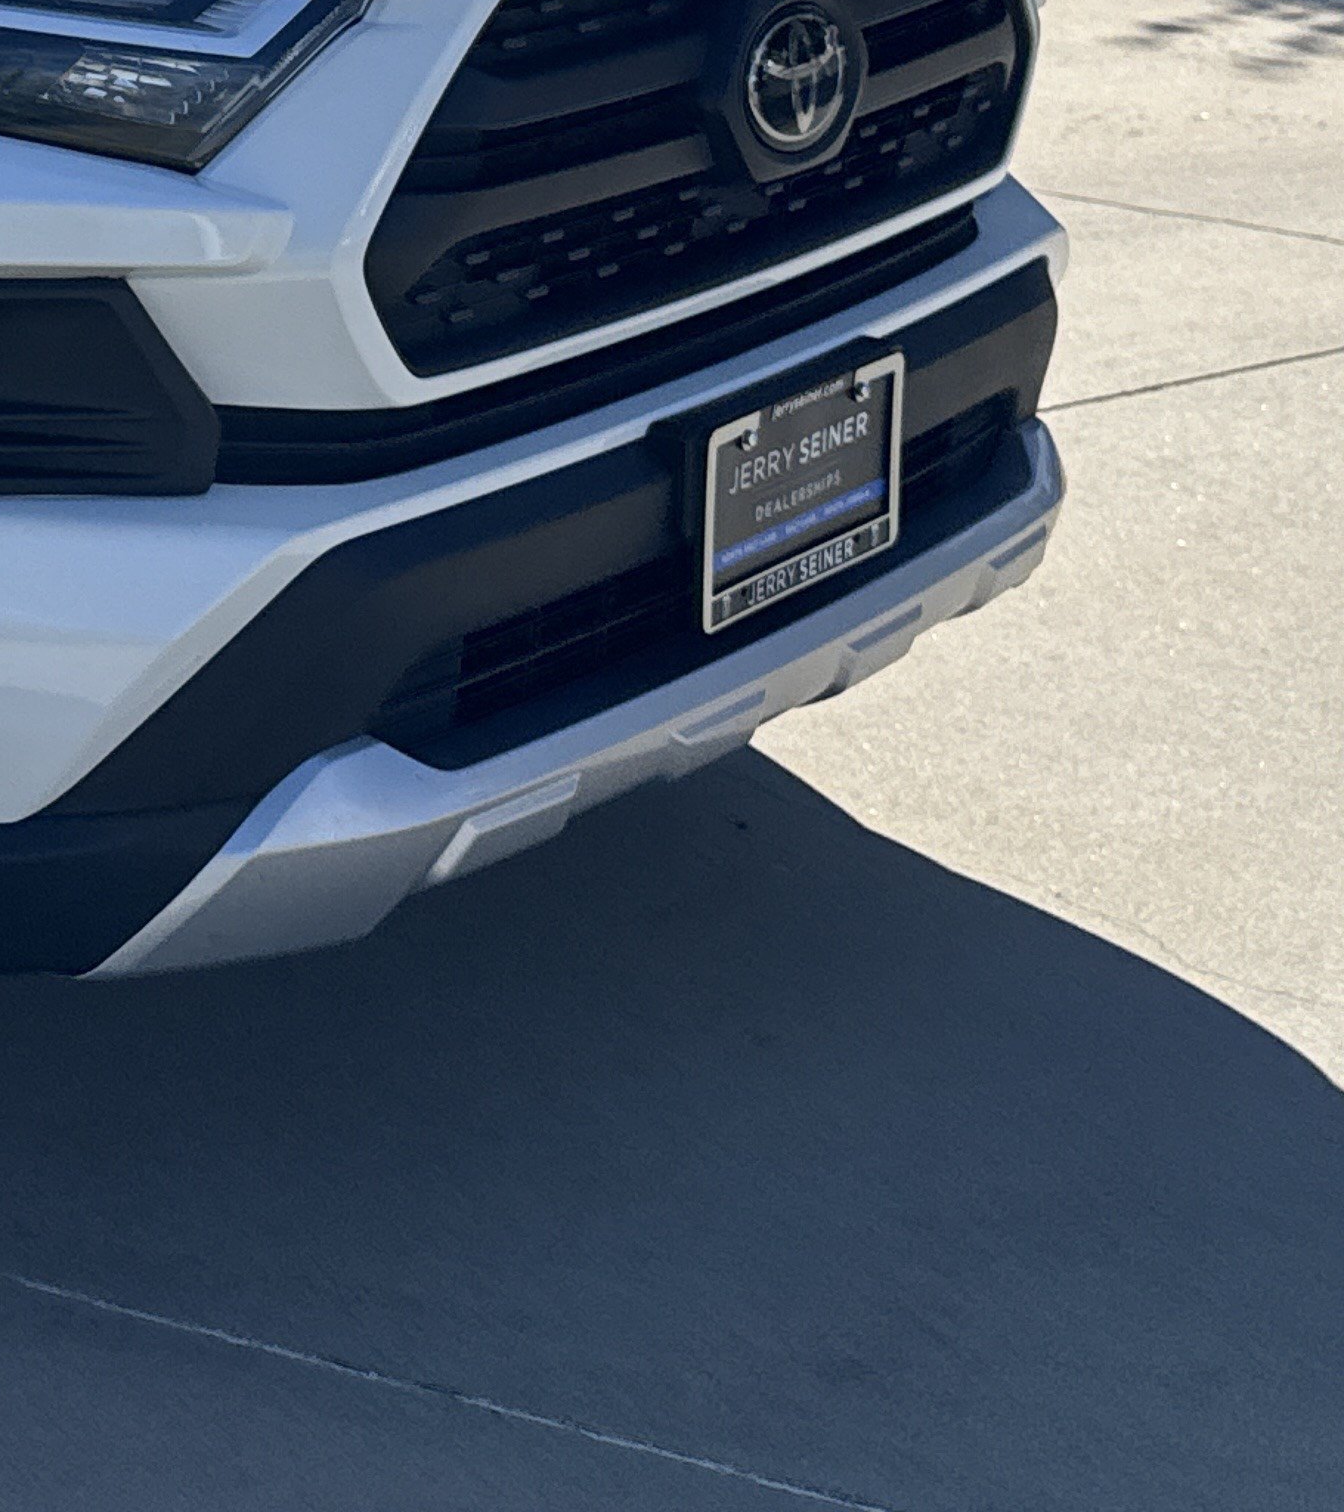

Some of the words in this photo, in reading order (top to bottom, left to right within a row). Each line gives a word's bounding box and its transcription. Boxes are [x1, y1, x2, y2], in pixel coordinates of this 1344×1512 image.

[728, 443, 796, 495] JERRY
[799, 410, 870, 466] SEINER
[754, 468, 842, 522] DEALERSHIPS
[746, 563, 797, 606] JERRY
[799, 538, 855, 582] SEINER
